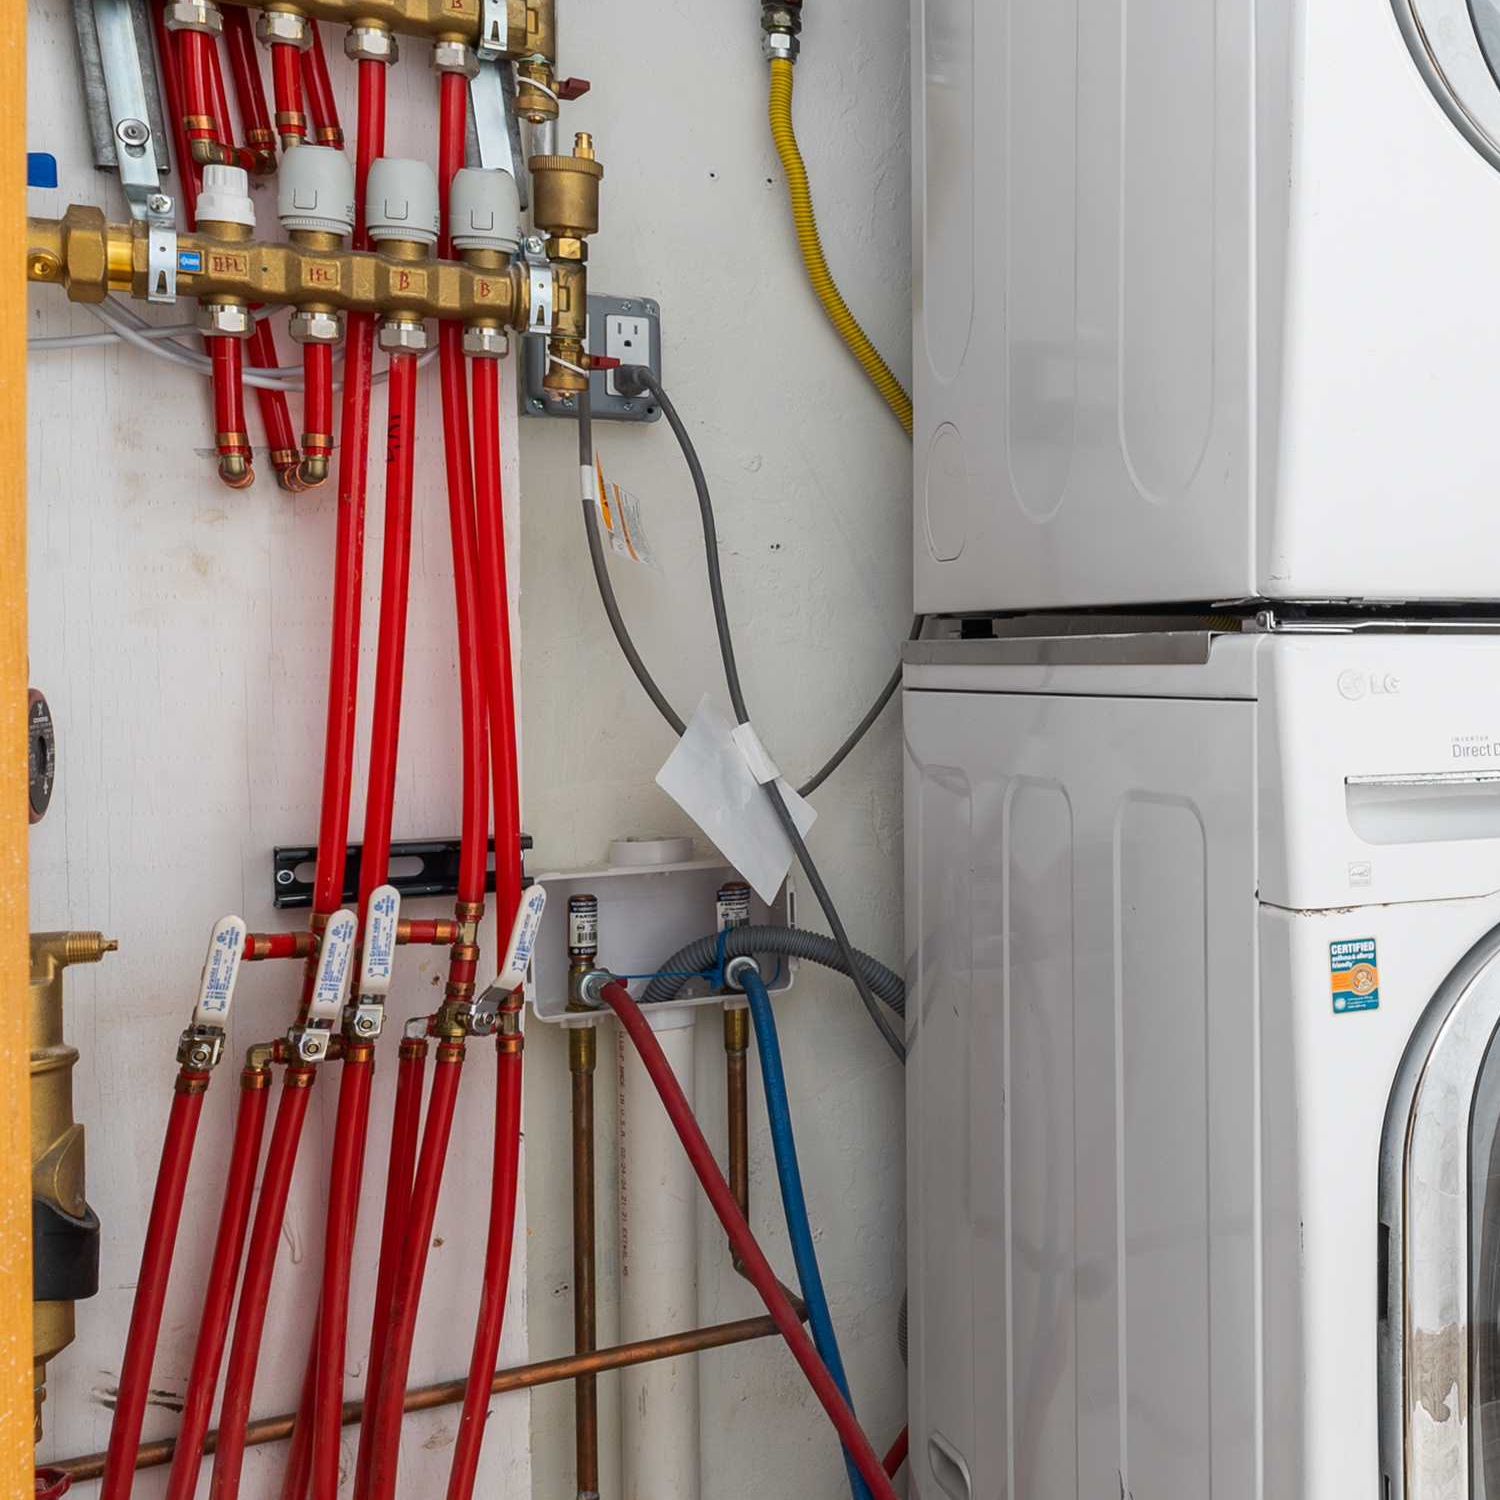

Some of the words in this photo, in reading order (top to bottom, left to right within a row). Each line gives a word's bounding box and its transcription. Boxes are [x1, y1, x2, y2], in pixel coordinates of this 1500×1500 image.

[399, 271, 409, 290] B
[480, 280, 490, 297] B
[1370, 673, 1401, 694] LG
[372, 916, 380, 934] valve
[369, 934, 378, 957] Granite
[1331, 941, 1375, 955] CERTIFIED
[211, 948, 221, 966] valve
[320, 958, 332, 982] Granite
[326, 941, 336, 958] valve
[1332, 954, 1352, 962] asthma
[1356, 952, 1374, 961] allergy
[205, 966, 218, 990] Granite
[619, 1094, 625, 1105] IN
[767, 1083, 783, 1119] LOCATIONS
